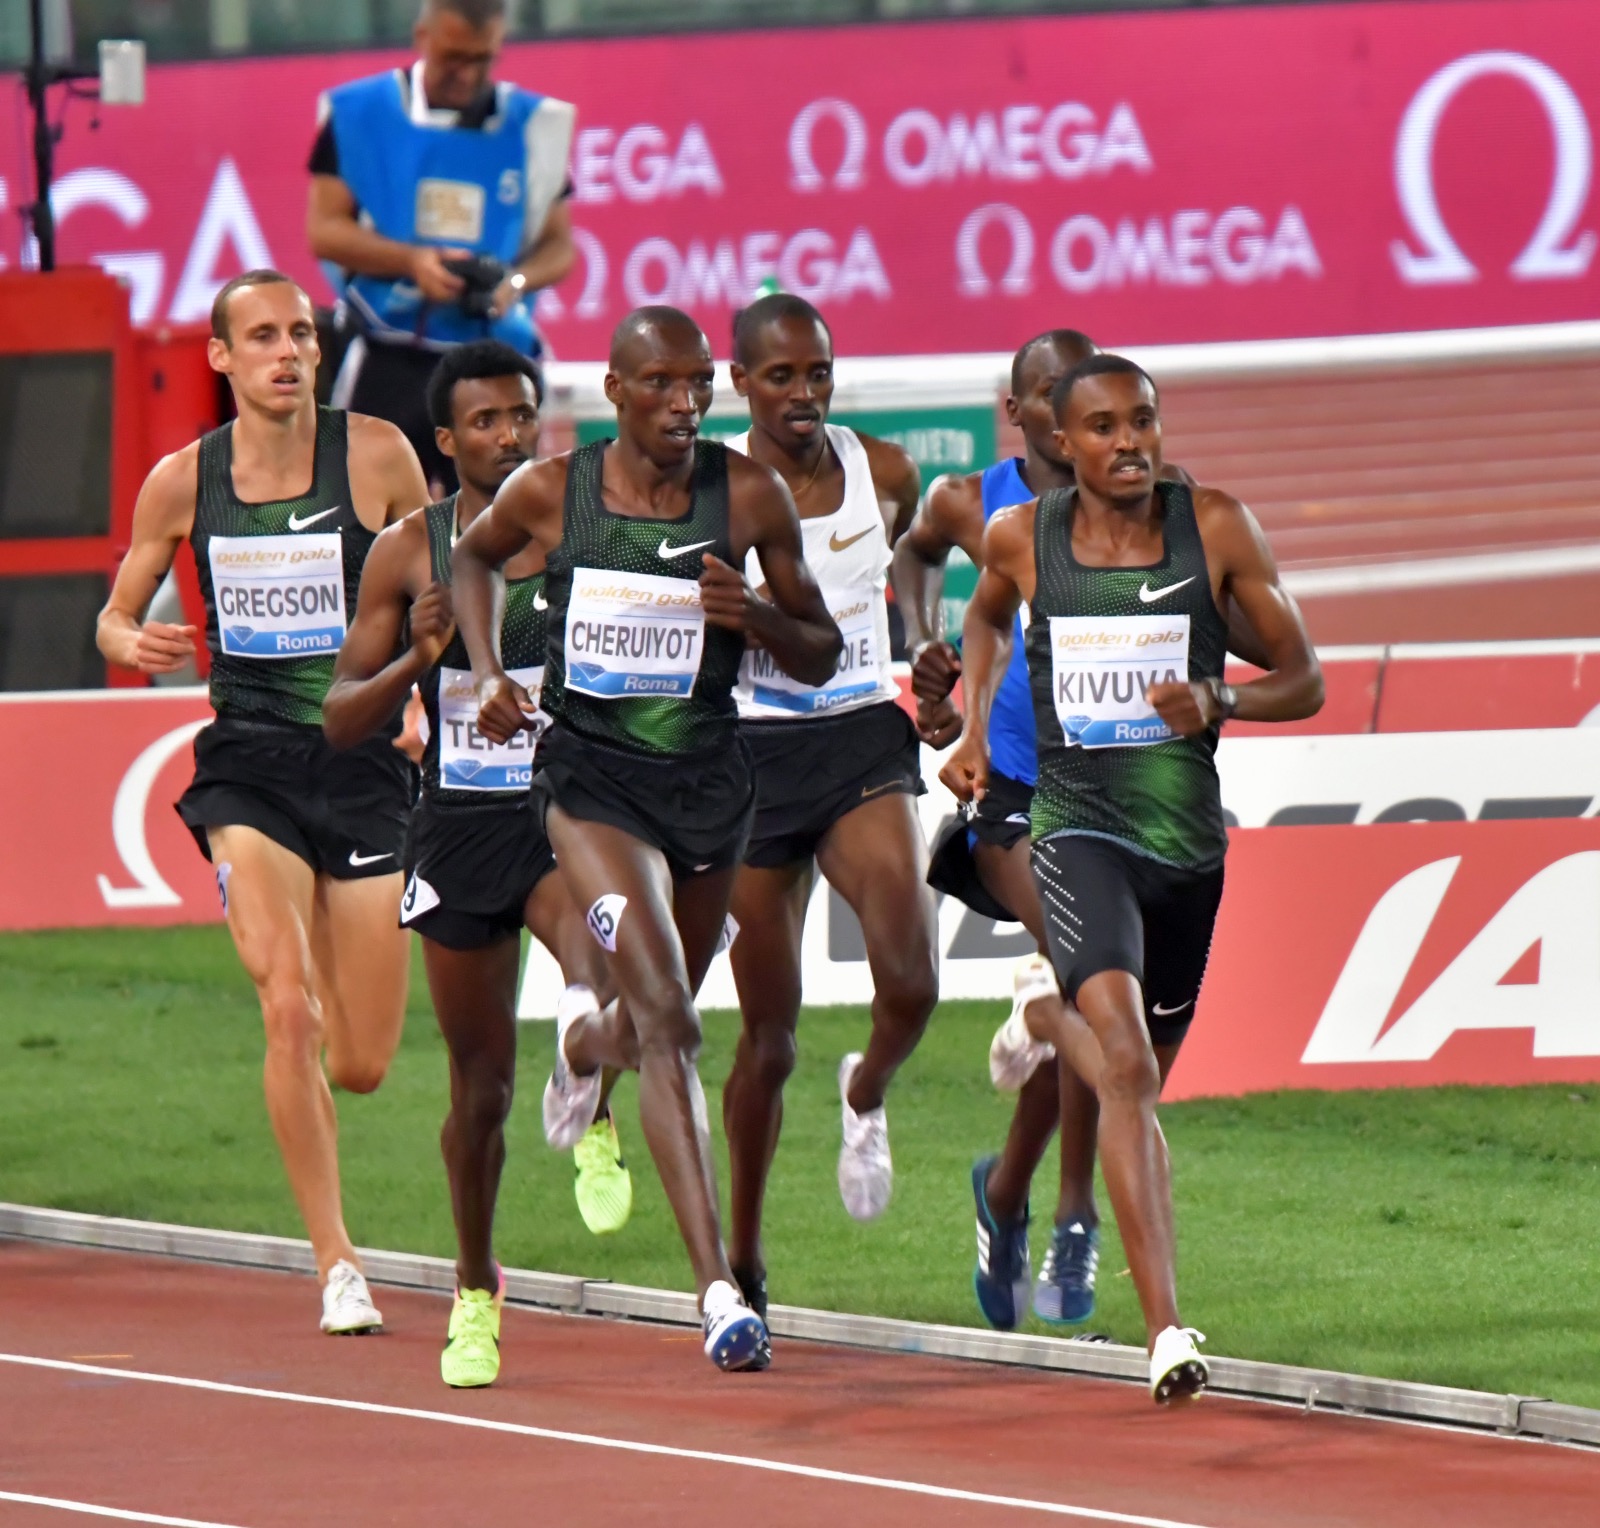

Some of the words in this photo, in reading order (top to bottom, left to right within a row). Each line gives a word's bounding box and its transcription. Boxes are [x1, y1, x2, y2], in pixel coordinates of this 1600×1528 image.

[883, 101, 1154, 189] OMEGA
[568, 121, 726, 204] EGA
[1051, 204, 1322, 293] OMEGA
[622, 226, 893, 309] OMEGA
[216, 551, 286, 565] golden
[289, 548, 337, 564] gala
[220, 583, 339, 617] GREGSON
[655, 593, 702, 607] gala
[276, 633, 333, 651] Roma
[571, 620, 698, 660] CHERUIYOT
[1058, 632, 1131, 648] golden
[1135, 630, 1185, 648] gala
[624, 675, 680, 691] Roma
[1114, 722, 1173, 741] Roma
[505, 767, 533, 784] Ro
[588, 900, 615, 946] 15
